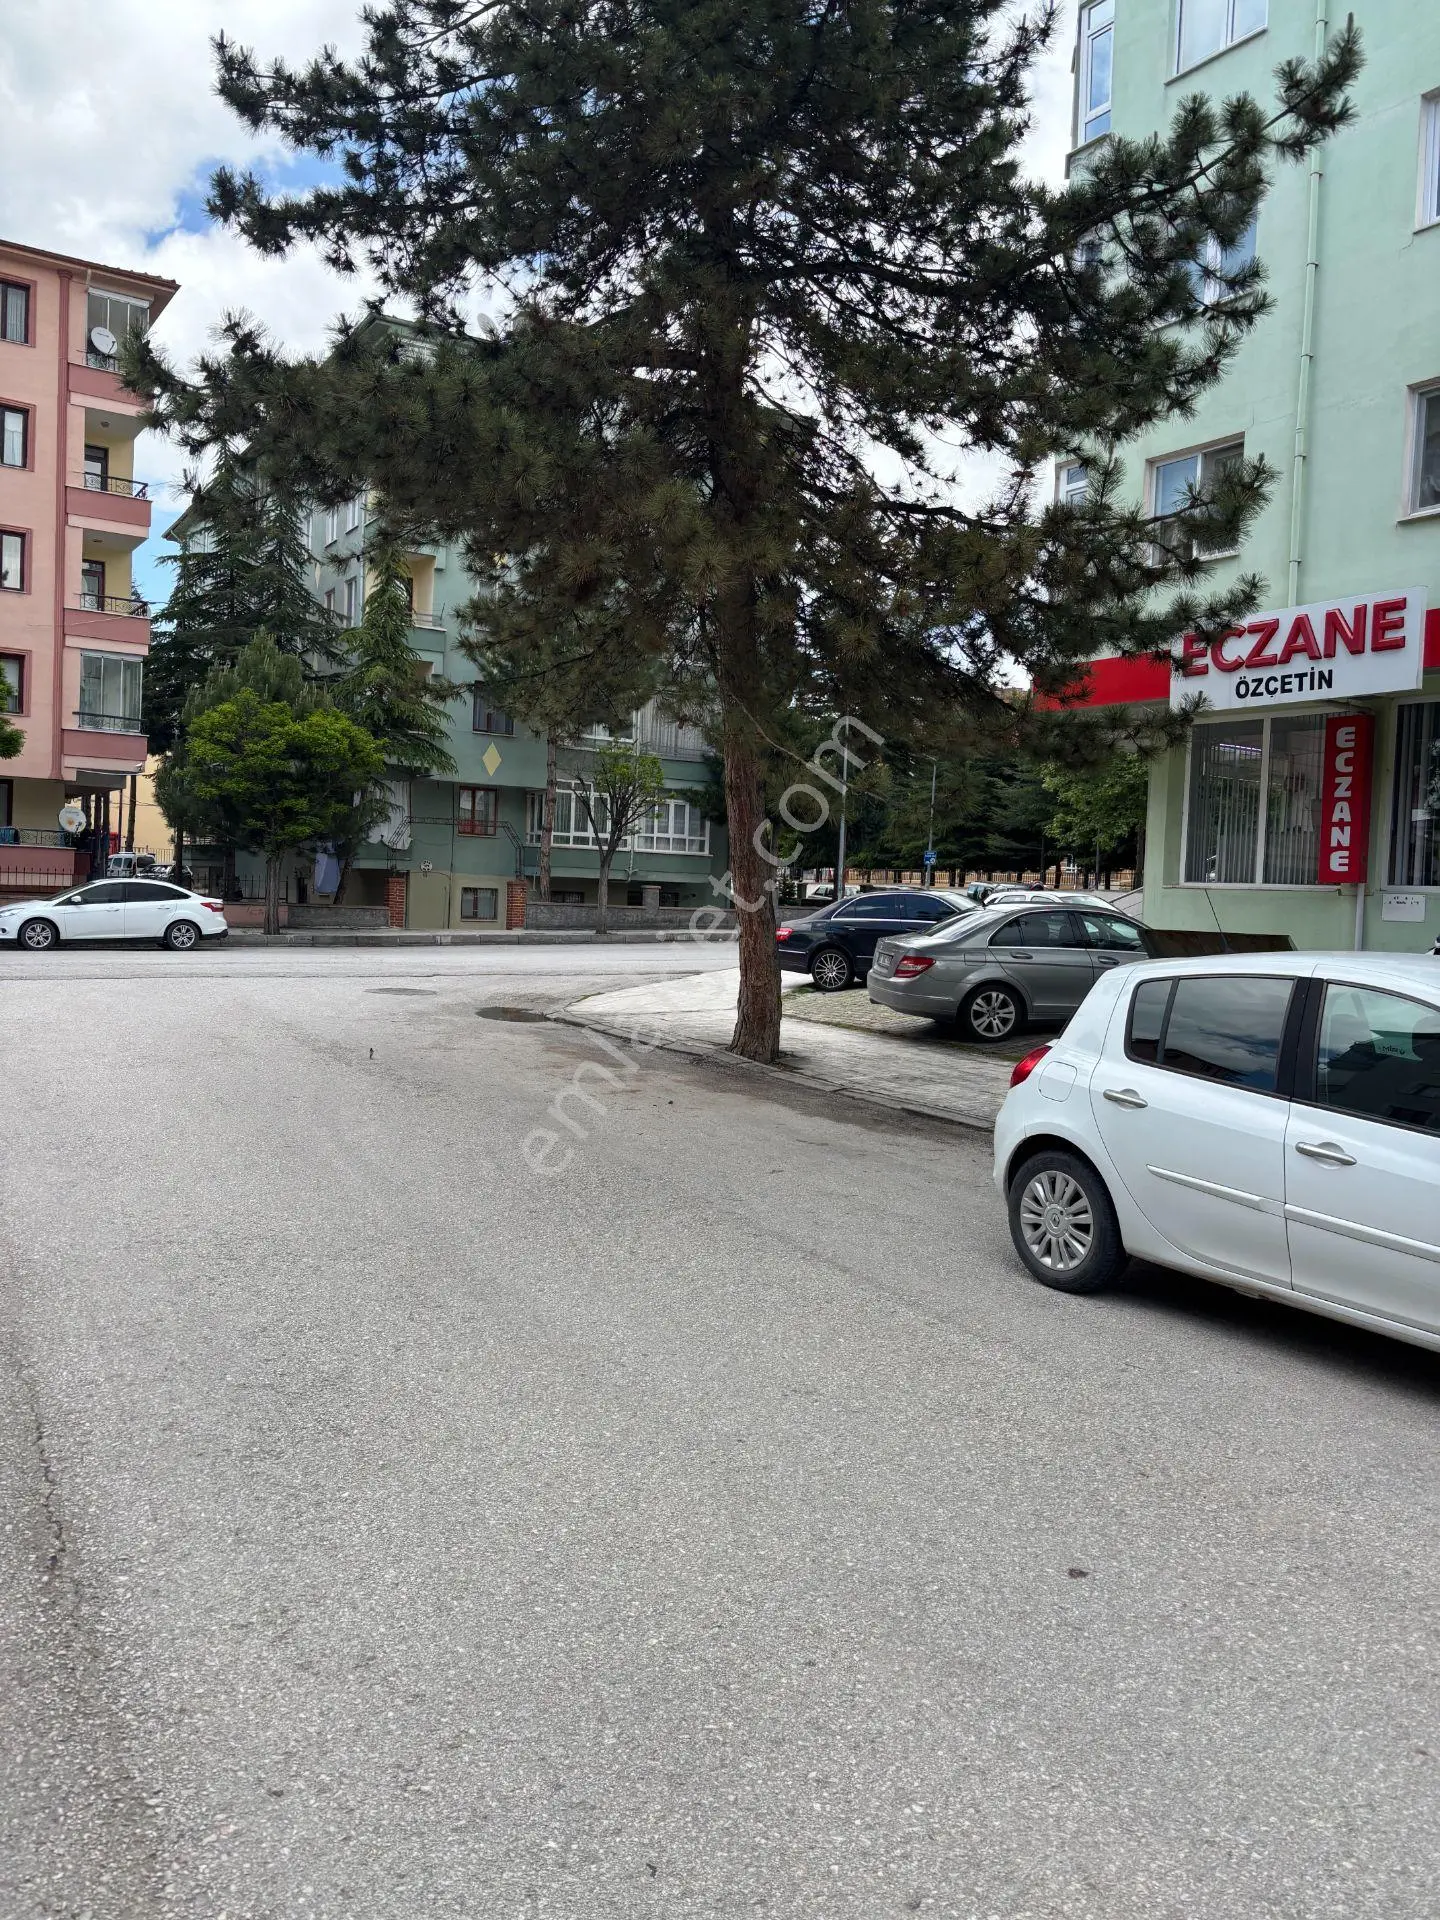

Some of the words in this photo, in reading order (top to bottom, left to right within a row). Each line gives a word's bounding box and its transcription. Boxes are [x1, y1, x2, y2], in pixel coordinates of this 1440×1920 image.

[1182, 597, 1407, 677] ECZANE
[1235, 666, 1334, 699] ÖZÇETİN
[1329, 726, 1356, 872] ECZANE
